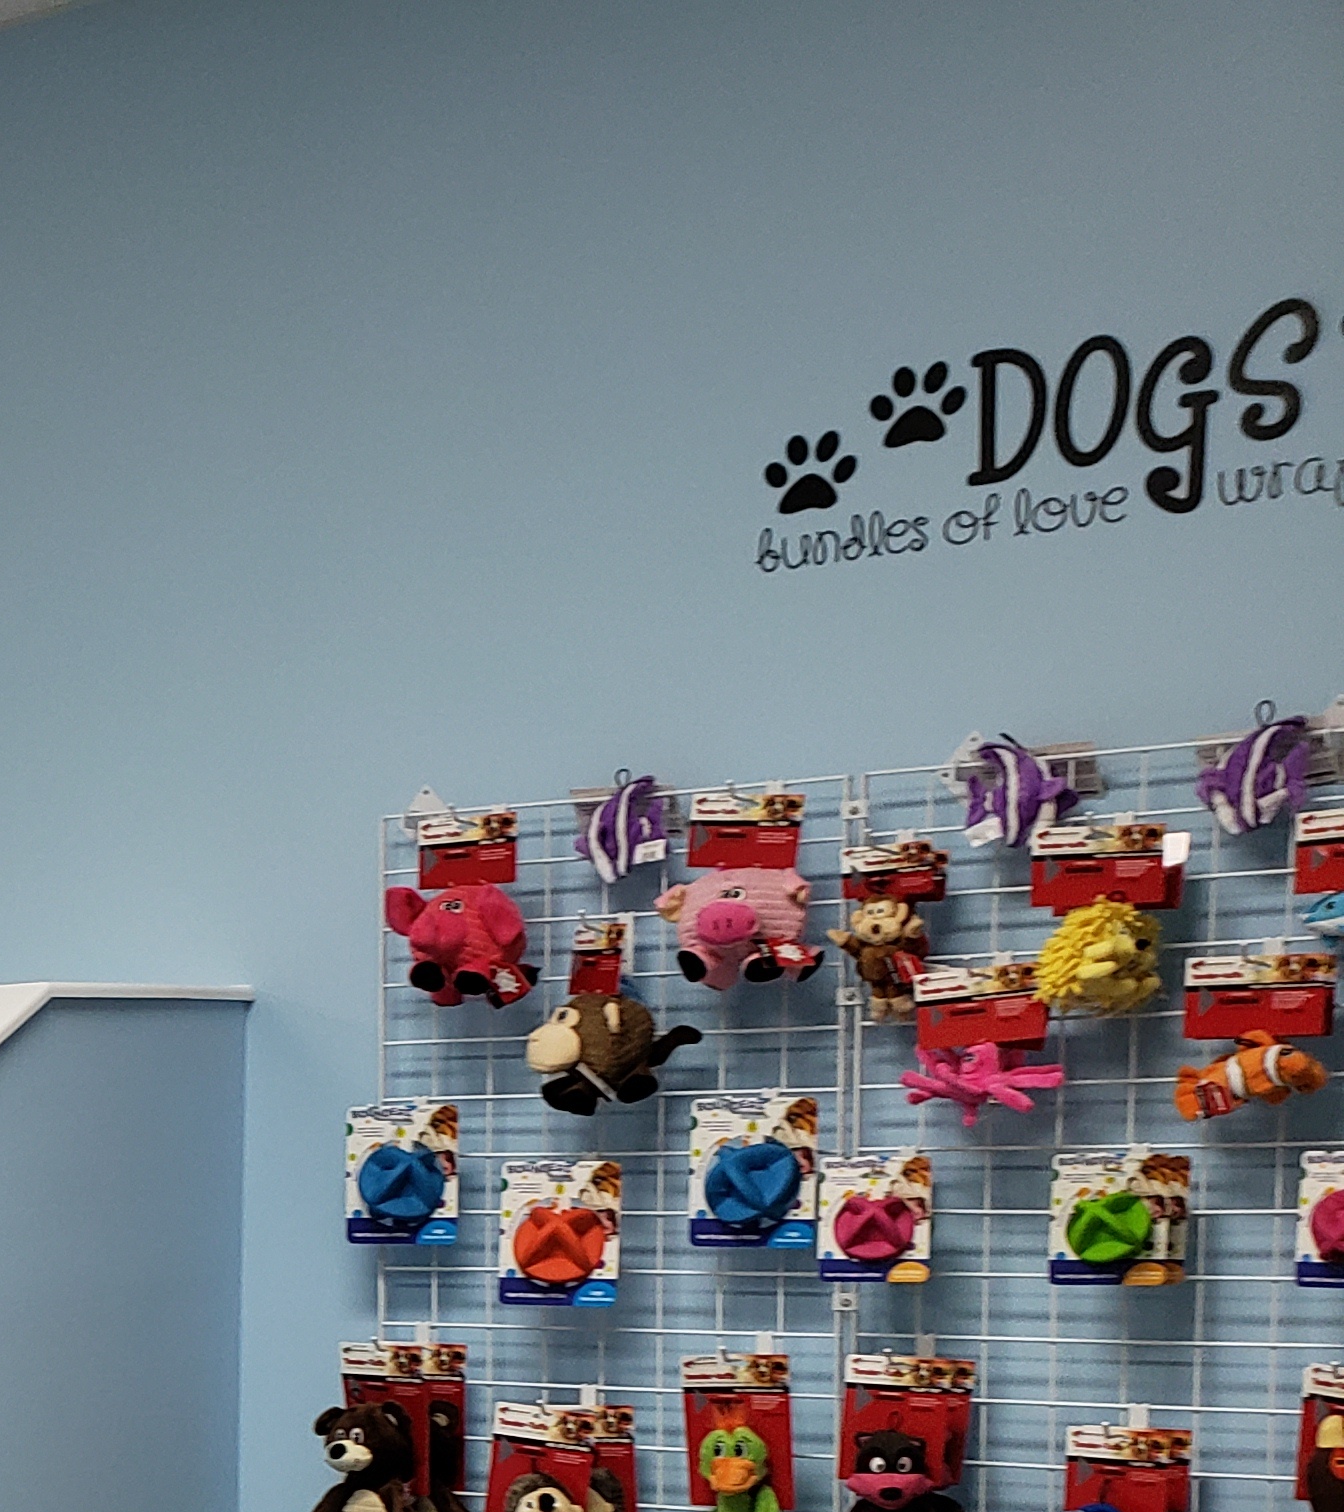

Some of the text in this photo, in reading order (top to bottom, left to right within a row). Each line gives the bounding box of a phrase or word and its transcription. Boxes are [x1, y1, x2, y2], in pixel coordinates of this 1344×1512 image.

[967, 298, 1319, 514] DOGS
[755, 510, 929, 573] bundles
[943, 492, 1000, 546] of
[1013, 486, 1130, 537] love
